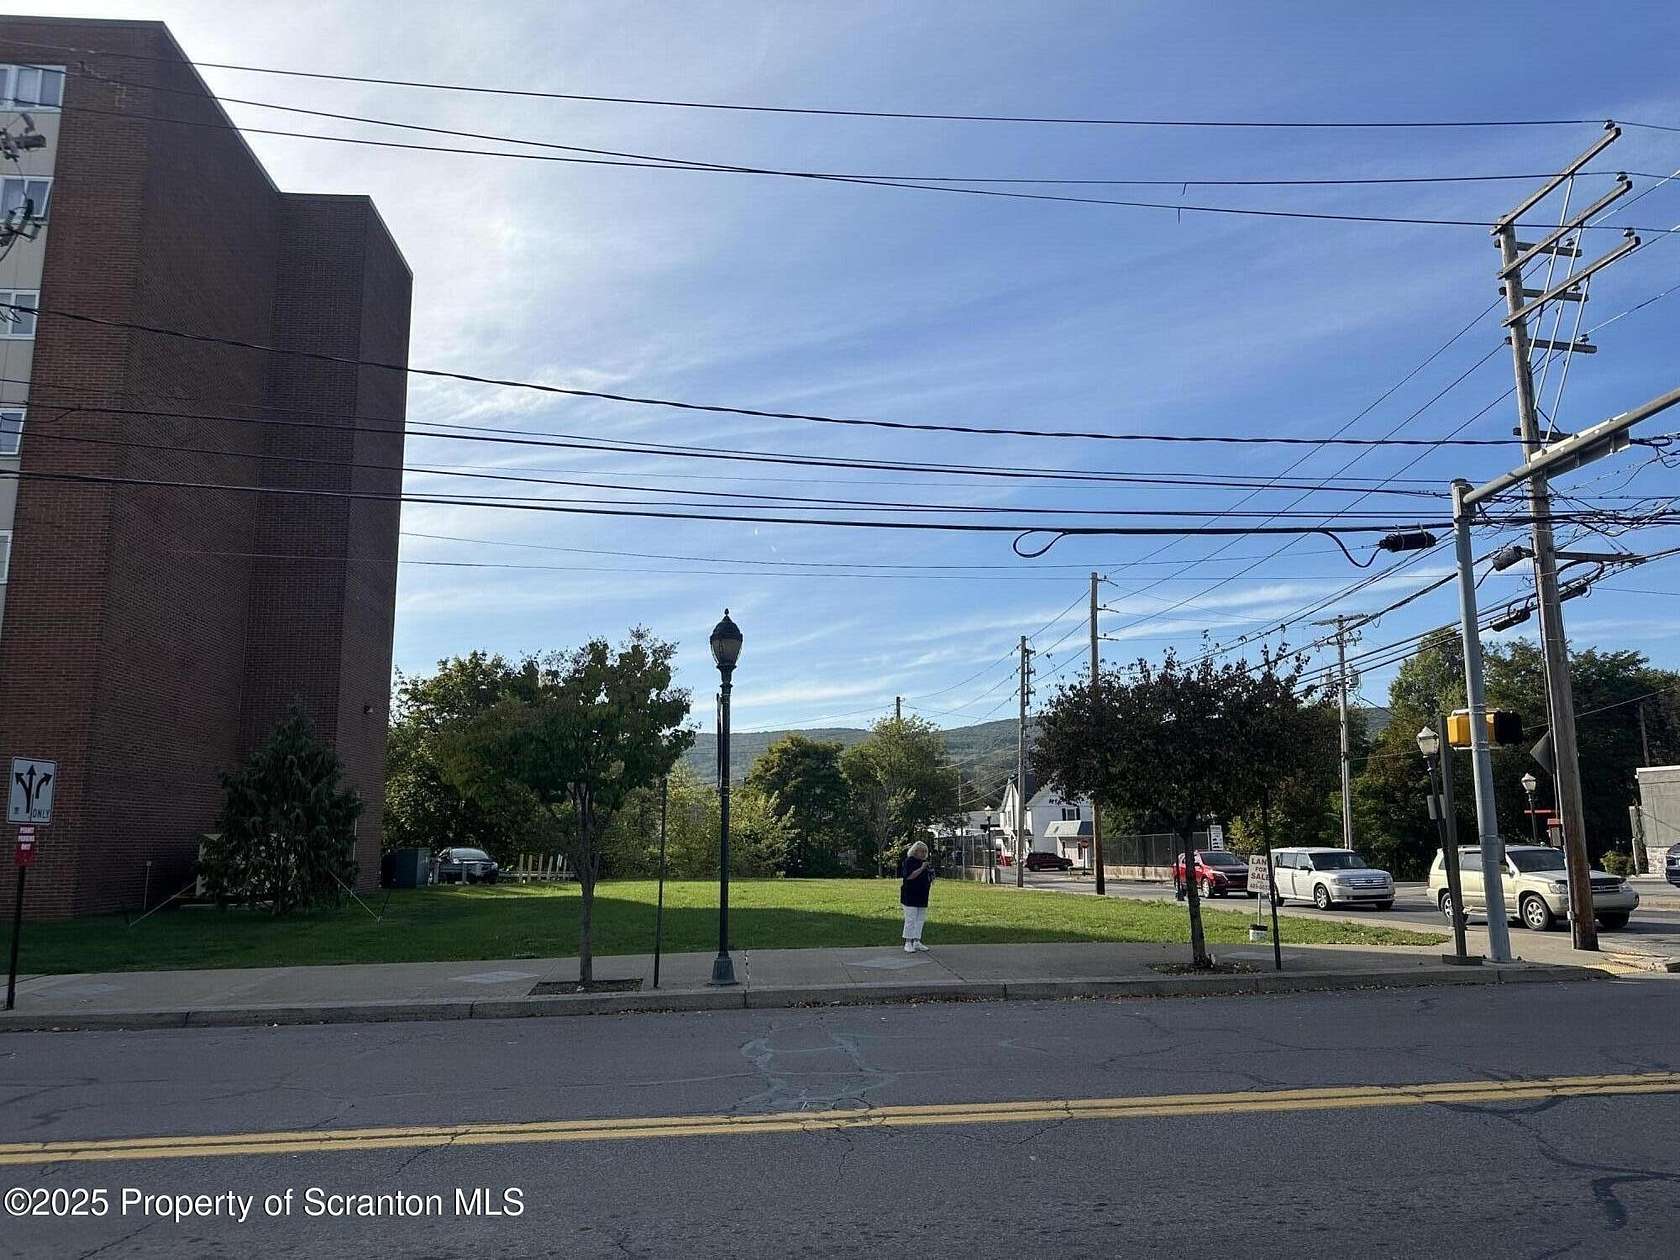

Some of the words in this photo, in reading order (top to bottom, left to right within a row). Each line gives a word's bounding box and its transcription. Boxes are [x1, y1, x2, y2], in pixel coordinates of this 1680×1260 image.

[32, 808, 50, 819] ONLY
[1251, 858, 1267, 866] LAN
[1250, 872, 1270, 881] SALE
